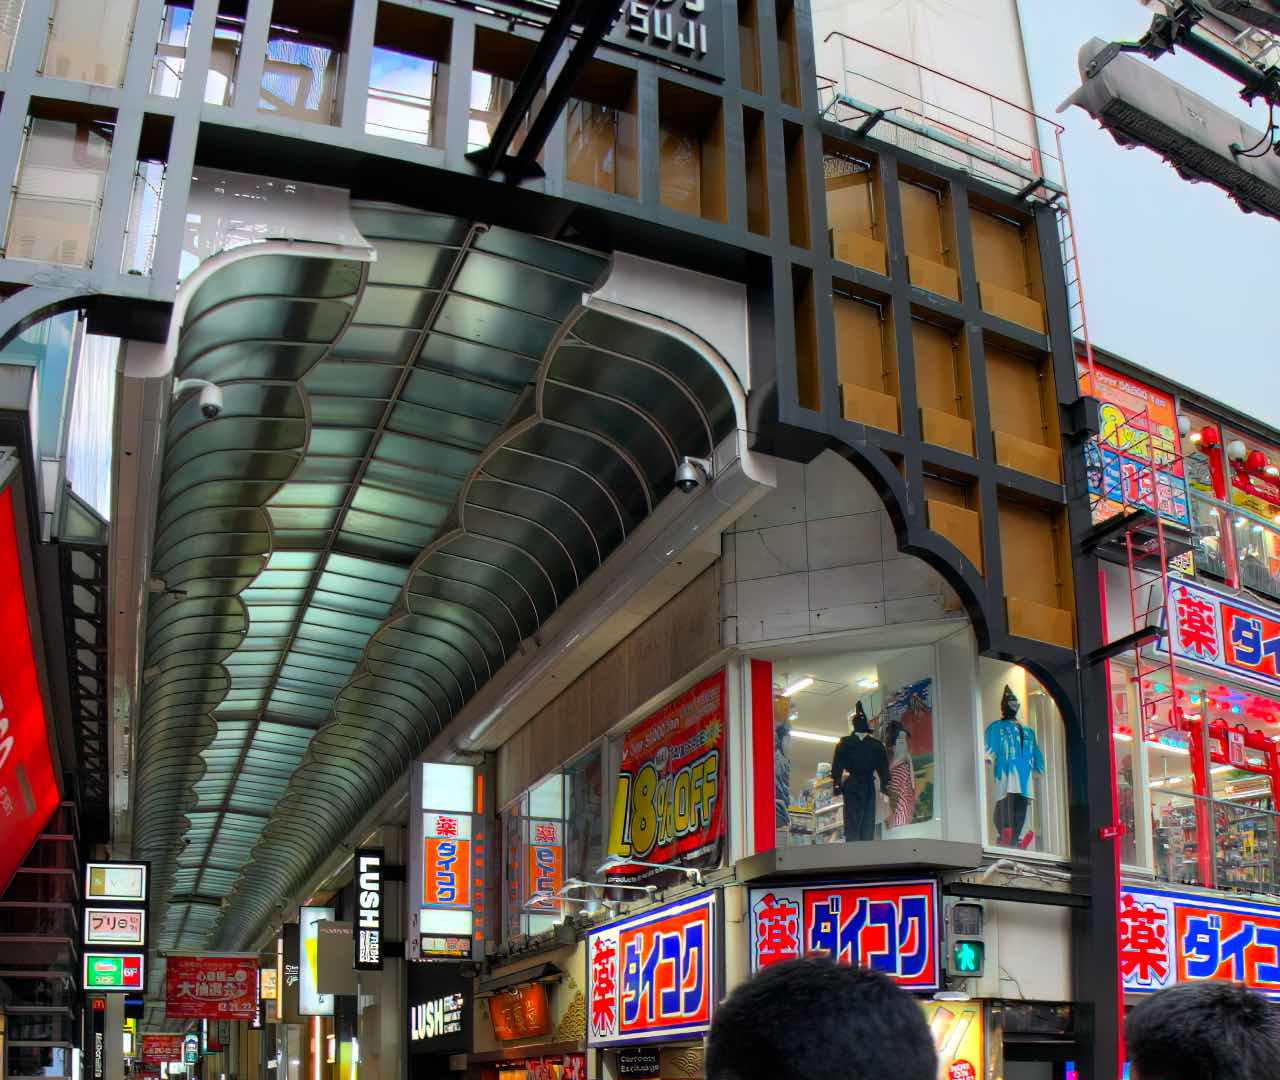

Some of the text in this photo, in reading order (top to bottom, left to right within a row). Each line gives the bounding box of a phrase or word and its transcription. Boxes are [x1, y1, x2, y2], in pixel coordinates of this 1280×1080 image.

[619, 2, 707, 53] SUJI
[1178, 585, 1219, 660] 薬
[360, 857, 380, 928] LUSH
[756, 893, 930, 977] 薬 ダイコク
[1120, 896, 1168, 983] 薬
[591, 936, 619, 1038] 薬
[623, 916, 707, 1027] ダイコク
[411, 999, 444, 1041] LUSH
